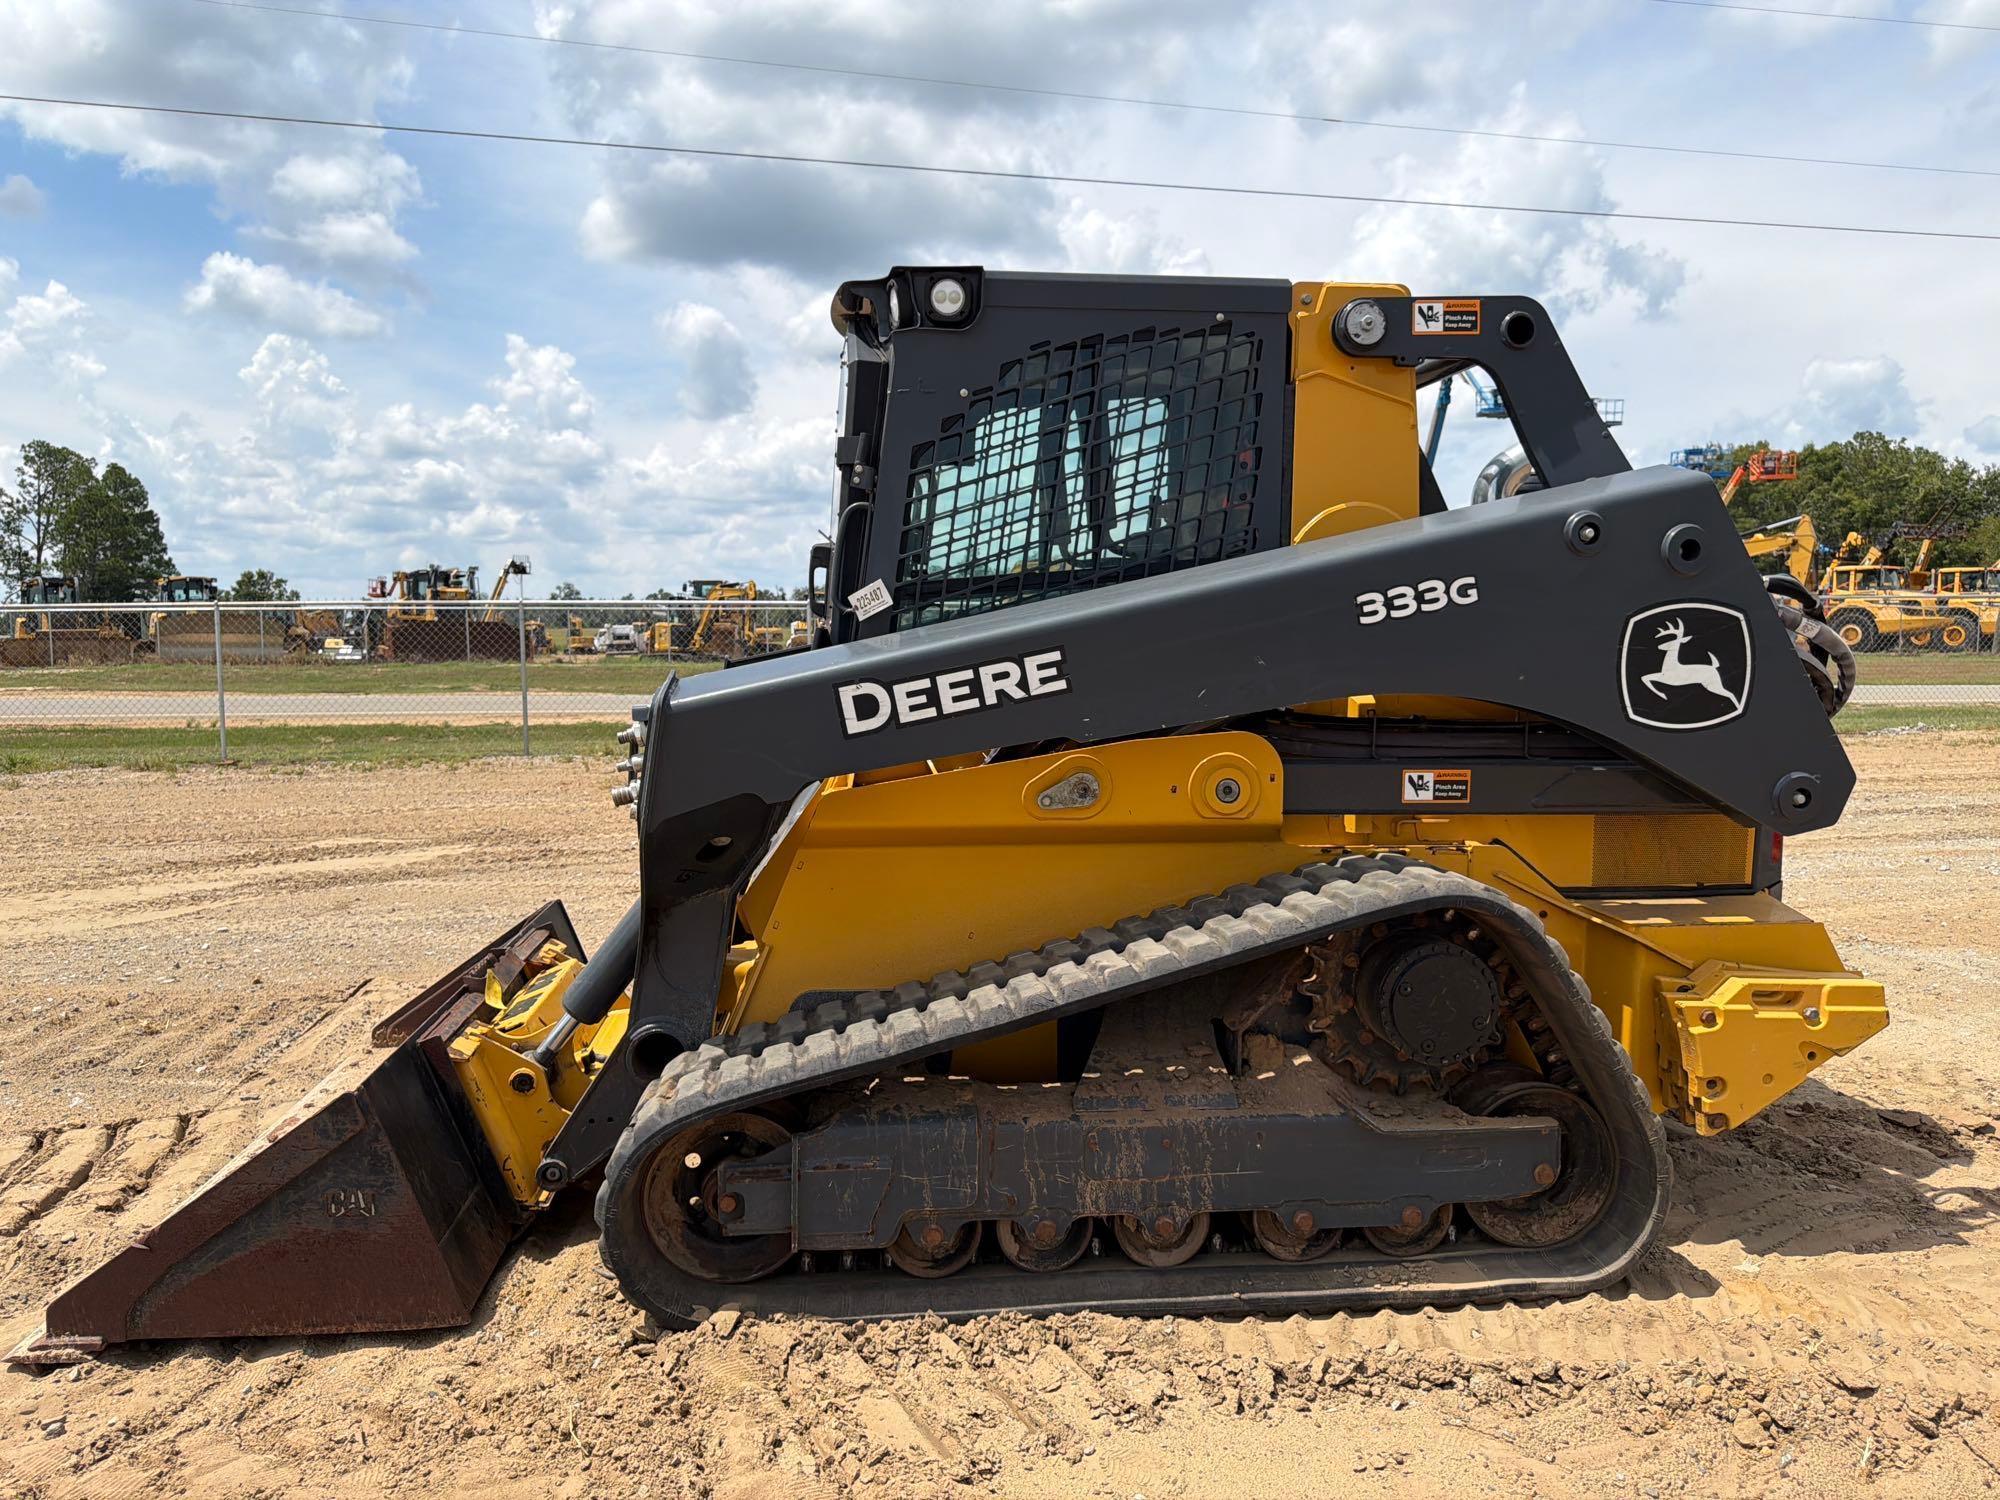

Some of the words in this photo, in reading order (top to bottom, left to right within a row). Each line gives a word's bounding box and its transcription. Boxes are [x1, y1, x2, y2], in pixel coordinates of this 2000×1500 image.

[856, 587, 884, 610] 225487
[1356, 576, 1479, 625] 333G
[838, 650, 1068, 735] DEERE
